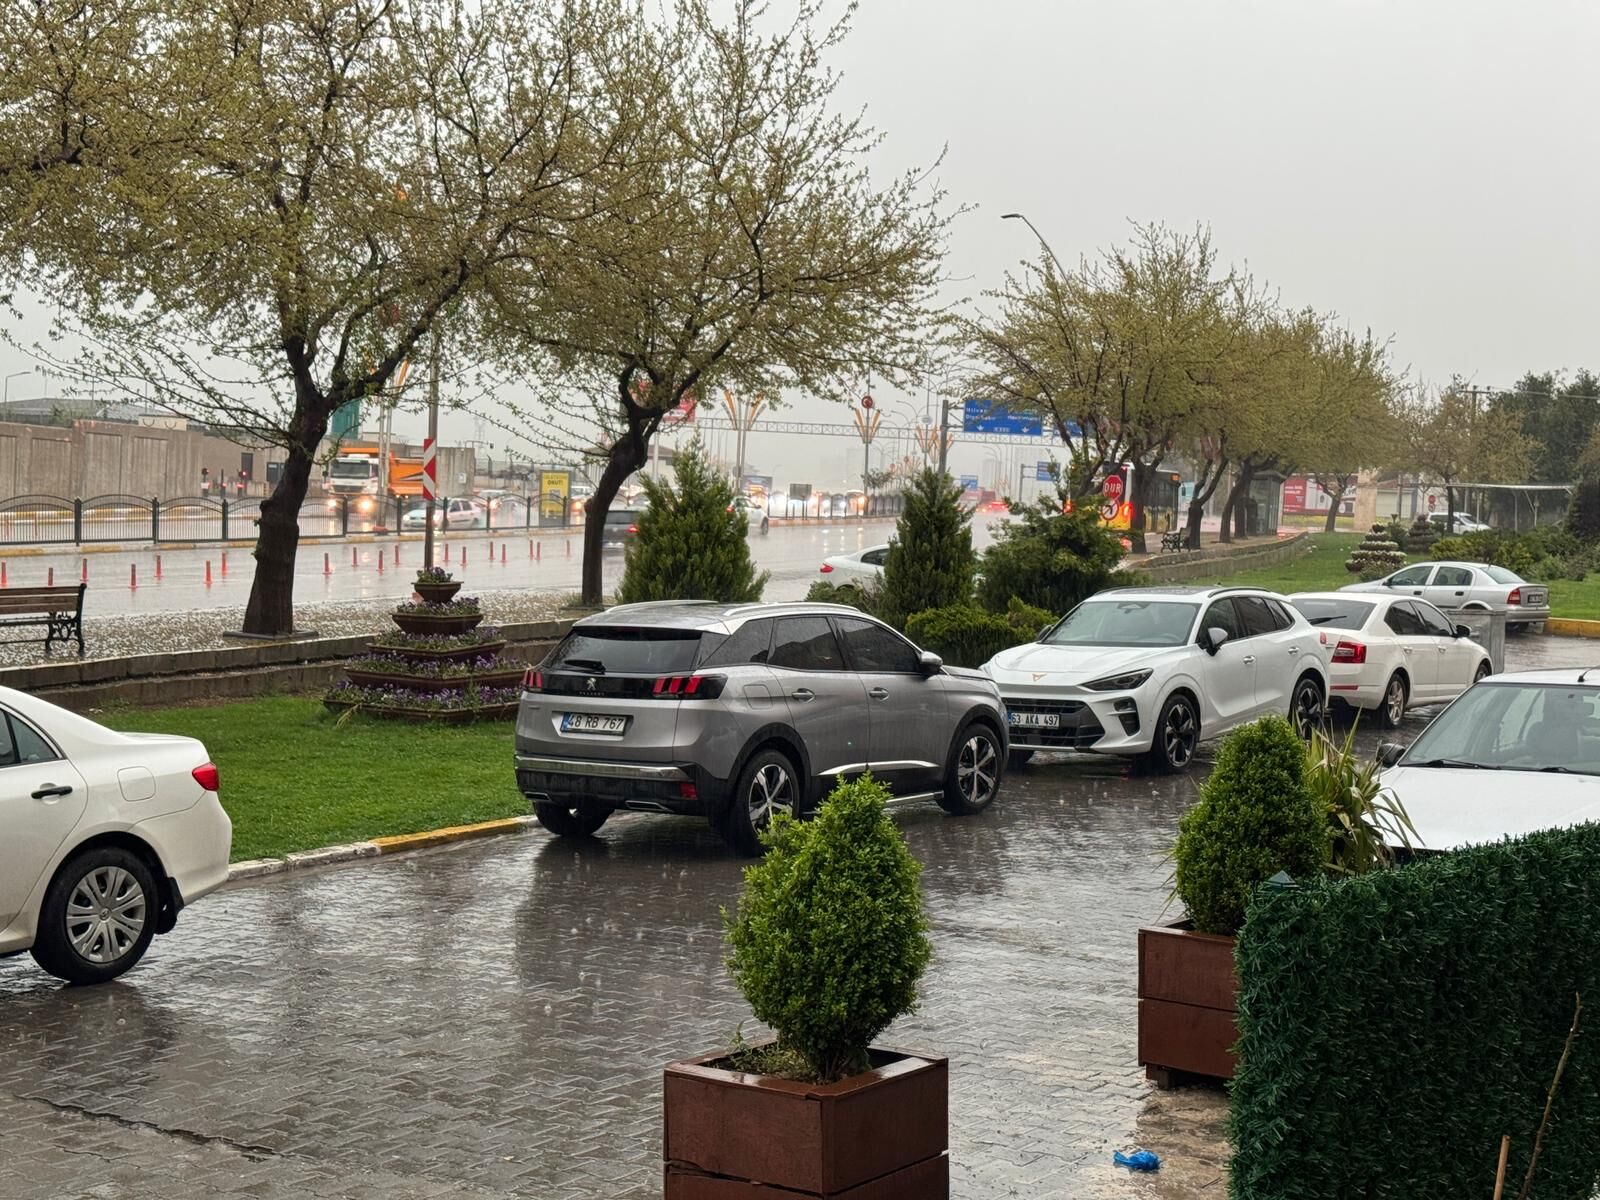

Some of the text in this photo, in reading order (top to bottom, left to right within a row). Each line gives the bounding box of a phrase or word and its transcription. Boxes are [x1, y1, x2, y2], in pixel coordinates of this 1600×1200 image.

[1104, 483, 1121, 493] DUR
[568, 714, 624, 730] 48 RB 767
[1011, 714, 1058, 726] 63 AKA 497
